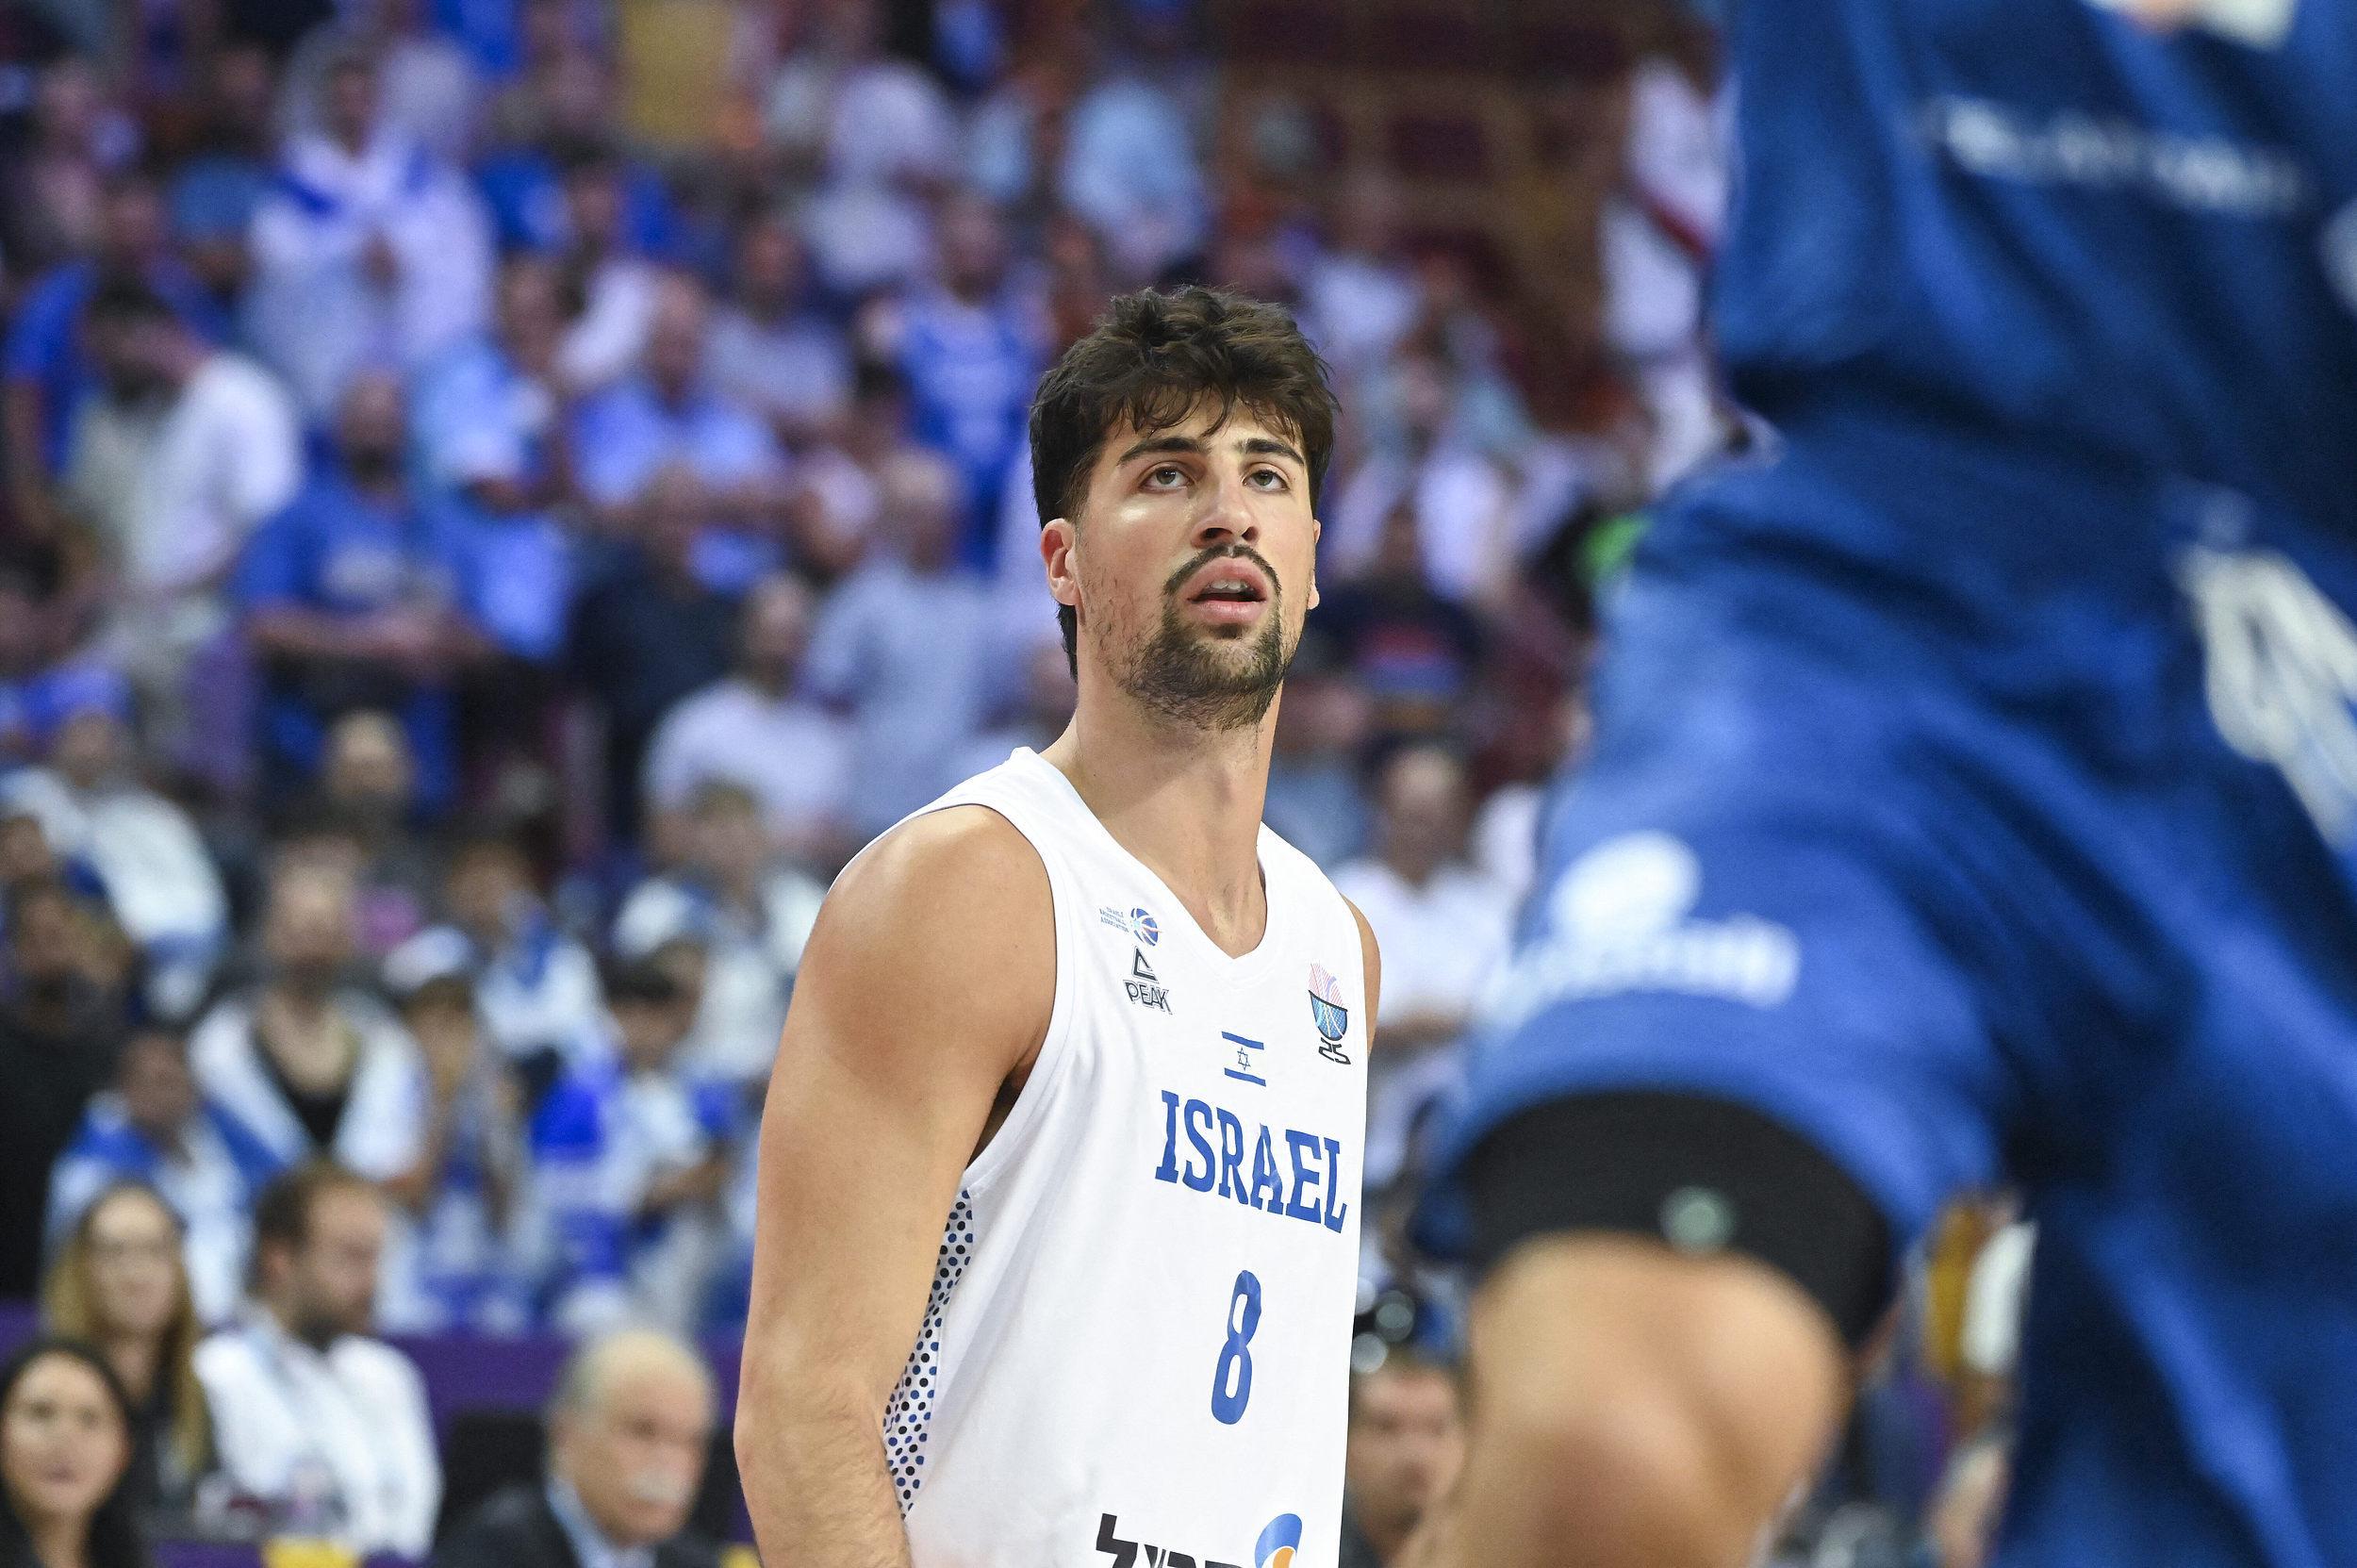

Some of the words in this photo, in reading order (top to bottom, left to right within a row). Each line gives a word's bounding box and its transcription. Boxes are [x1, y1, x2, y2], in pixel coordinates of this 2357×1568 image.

[1124, 981, 1172, 1013] PEAK
[1155, 1090, 1347, 1234] ISRAEL
[1211, 1269, 1261, 1425] 8
